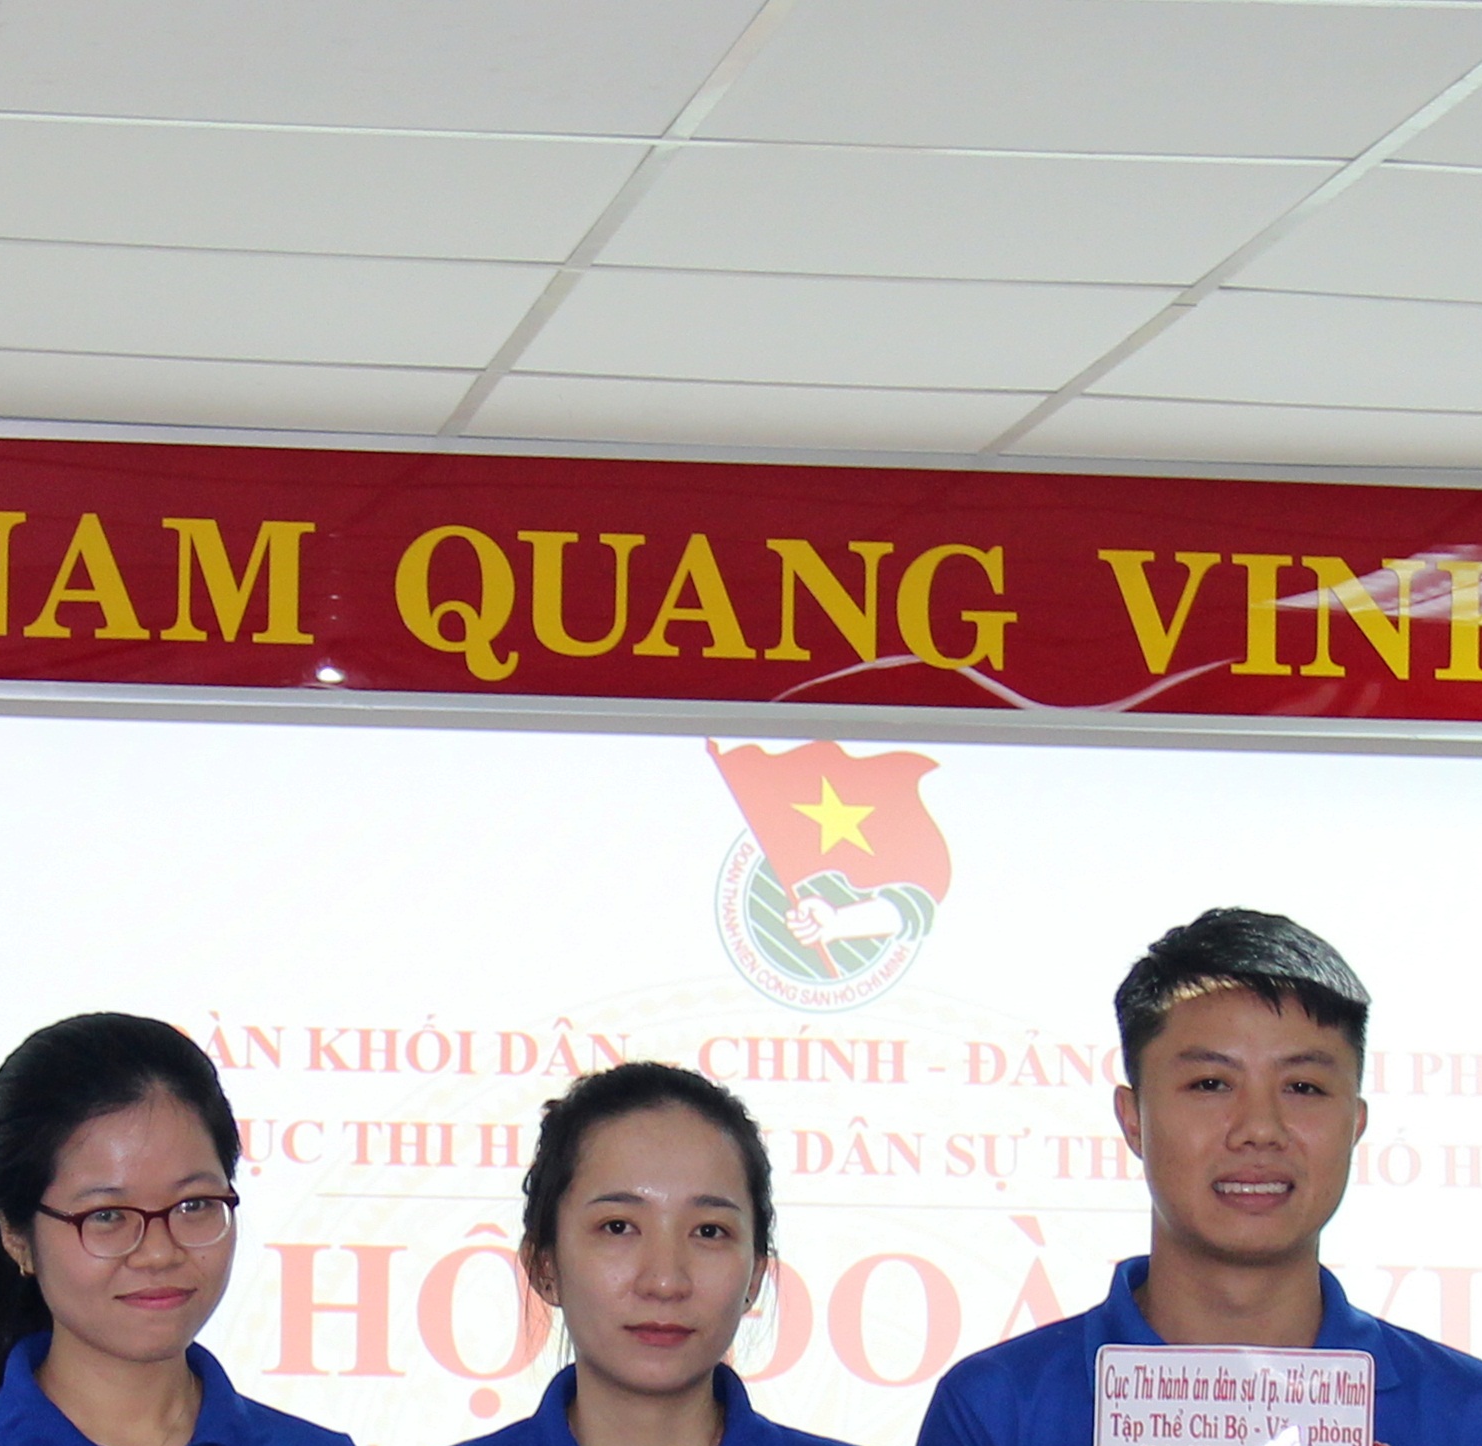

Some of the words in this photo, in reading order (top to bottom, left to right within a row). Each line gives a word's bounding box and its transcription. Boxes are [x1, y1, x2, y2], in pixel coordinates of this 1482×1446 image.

[394, 524, 1019, 682] QUANG
[178, 1011, 282, 1070] ÀN
[304, 1014, 478, 1074] KHỐI
[495, 1016, 630, 1077] DÂN
[697, 1025, 909, 1084] CHÍNH
[239, 1118, 324, 1177] ỤC
[342, 1120, 458, 1168] THI
[791, 1115, 926, 1176] DÂN
[944, 1128, 1031, 1191] SỰ
[262, 1222, 552, 1419] HỘ
[1104, 1364, 1129, 1409] Cục
[1133, 1364, 1154, 1400] Thi
[1158, 1365, 1189, 1400] hành
[1193, 1367, 1209, 1401] án
[1213, 1366, 1237, 1402] dân
[1240, 1373, 1257, 1412] sự
[1260, 1368, 1280, 1411] Tp.
[1285, 1363, 1305, 1404] Hồ
[1309, 1368, 1331, 1405] Chí
[1334, 1371, 1366, 1406] Minh
[1110, 1413, 1144, 1442] Tập
[1149, 1408, 1184, 1438] Thể
[1189, 1414, 1219, 1439] Chi
[1224, 1415, 1248, 1445] Bộ
